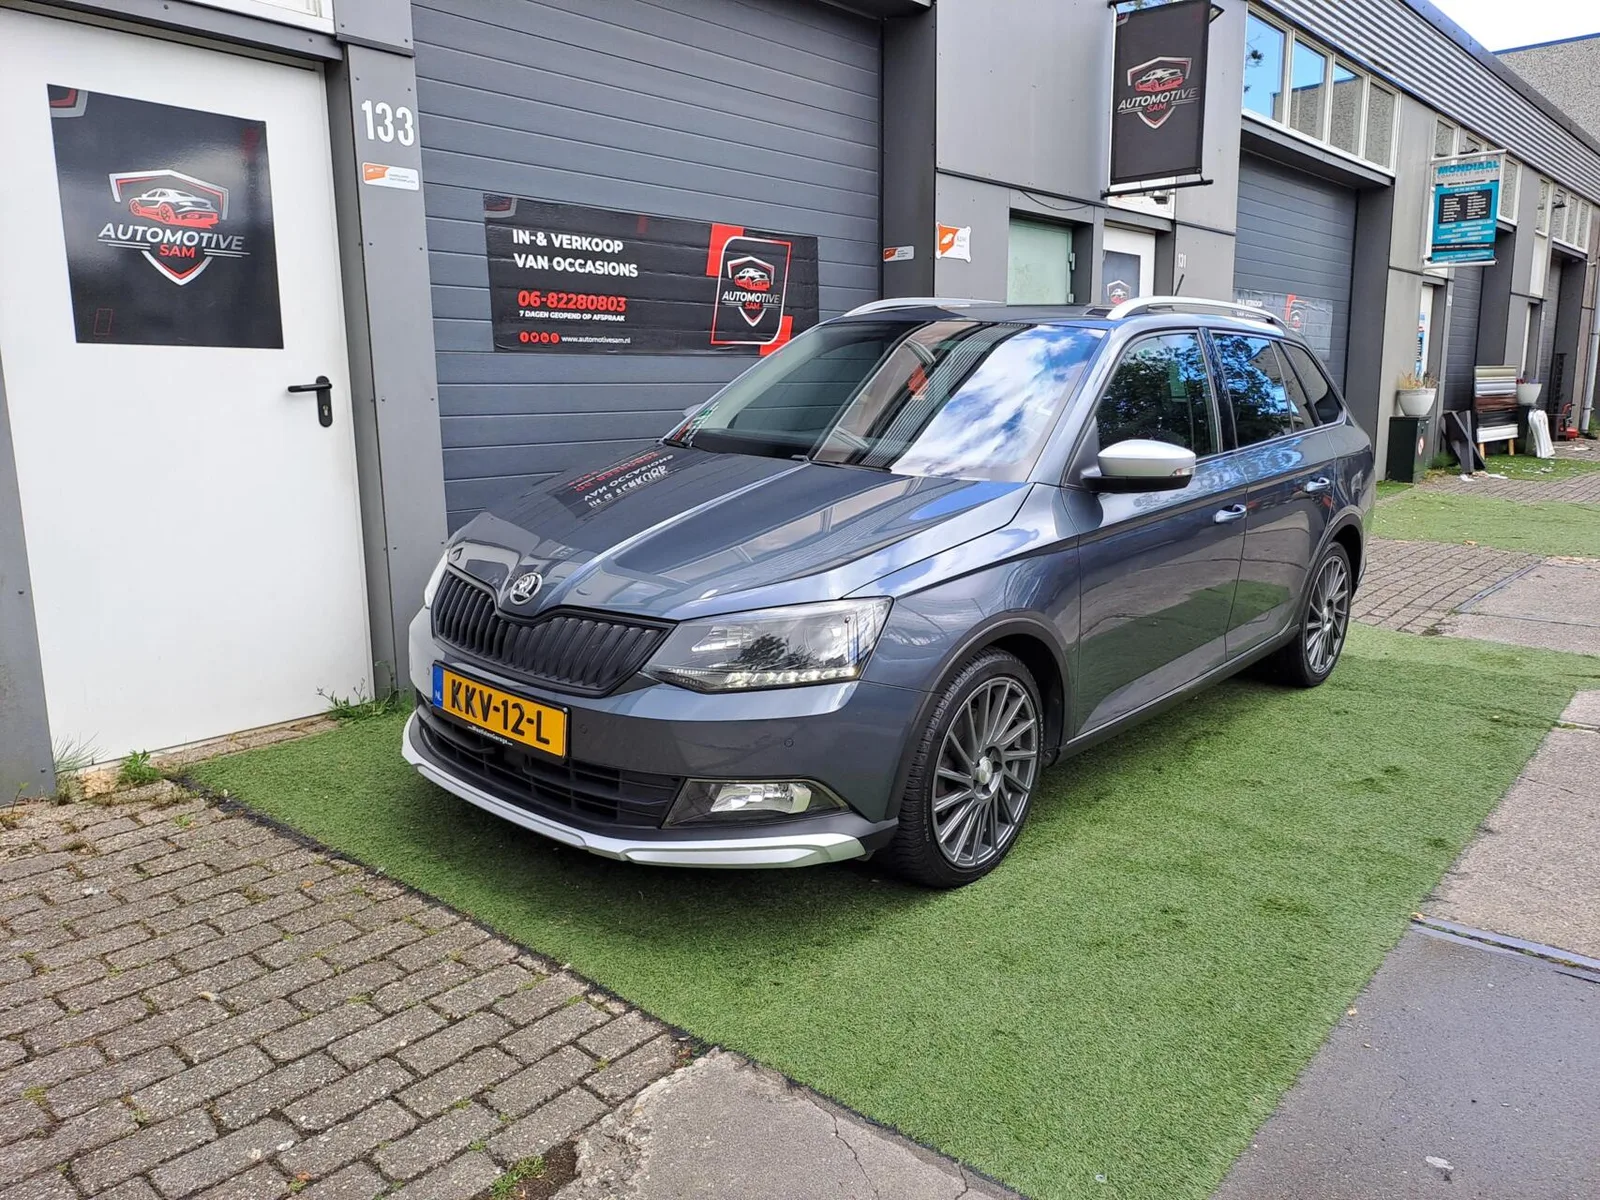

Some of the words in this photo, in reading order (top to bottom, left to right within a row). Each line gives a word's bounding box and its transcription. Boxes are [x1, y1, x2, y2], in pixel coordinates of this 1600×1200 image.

[1118, 87, 1198, 111] AUTOMOTIVE
[1146, 103, 1167, 113] SAM
[361, 100, 415, 146] 133
[98, 222, 245, 250] AUTOMOTIVE
[550, 233, 624, 254] VERKOOP
[159, 244, 196, 258] SAM
[513, 253, 549, 270] VAN
[552, 256, 639, 278] OCCASIONS
[518, 290, 627, 312] 06-82280803
[722, 291, 780, 304] AUTOMOTIVE
[744, 302, 760, 310] SAM
[525, 311, 549, 319] DAGEN
[550, 312, 582, 320] GEOPEND
[592, 314, 626, 322] AFSPRAAK
[561, 336, 631, 344] www.automotivesam.nl
[450, 678, 551, 745] KKV-12-L
